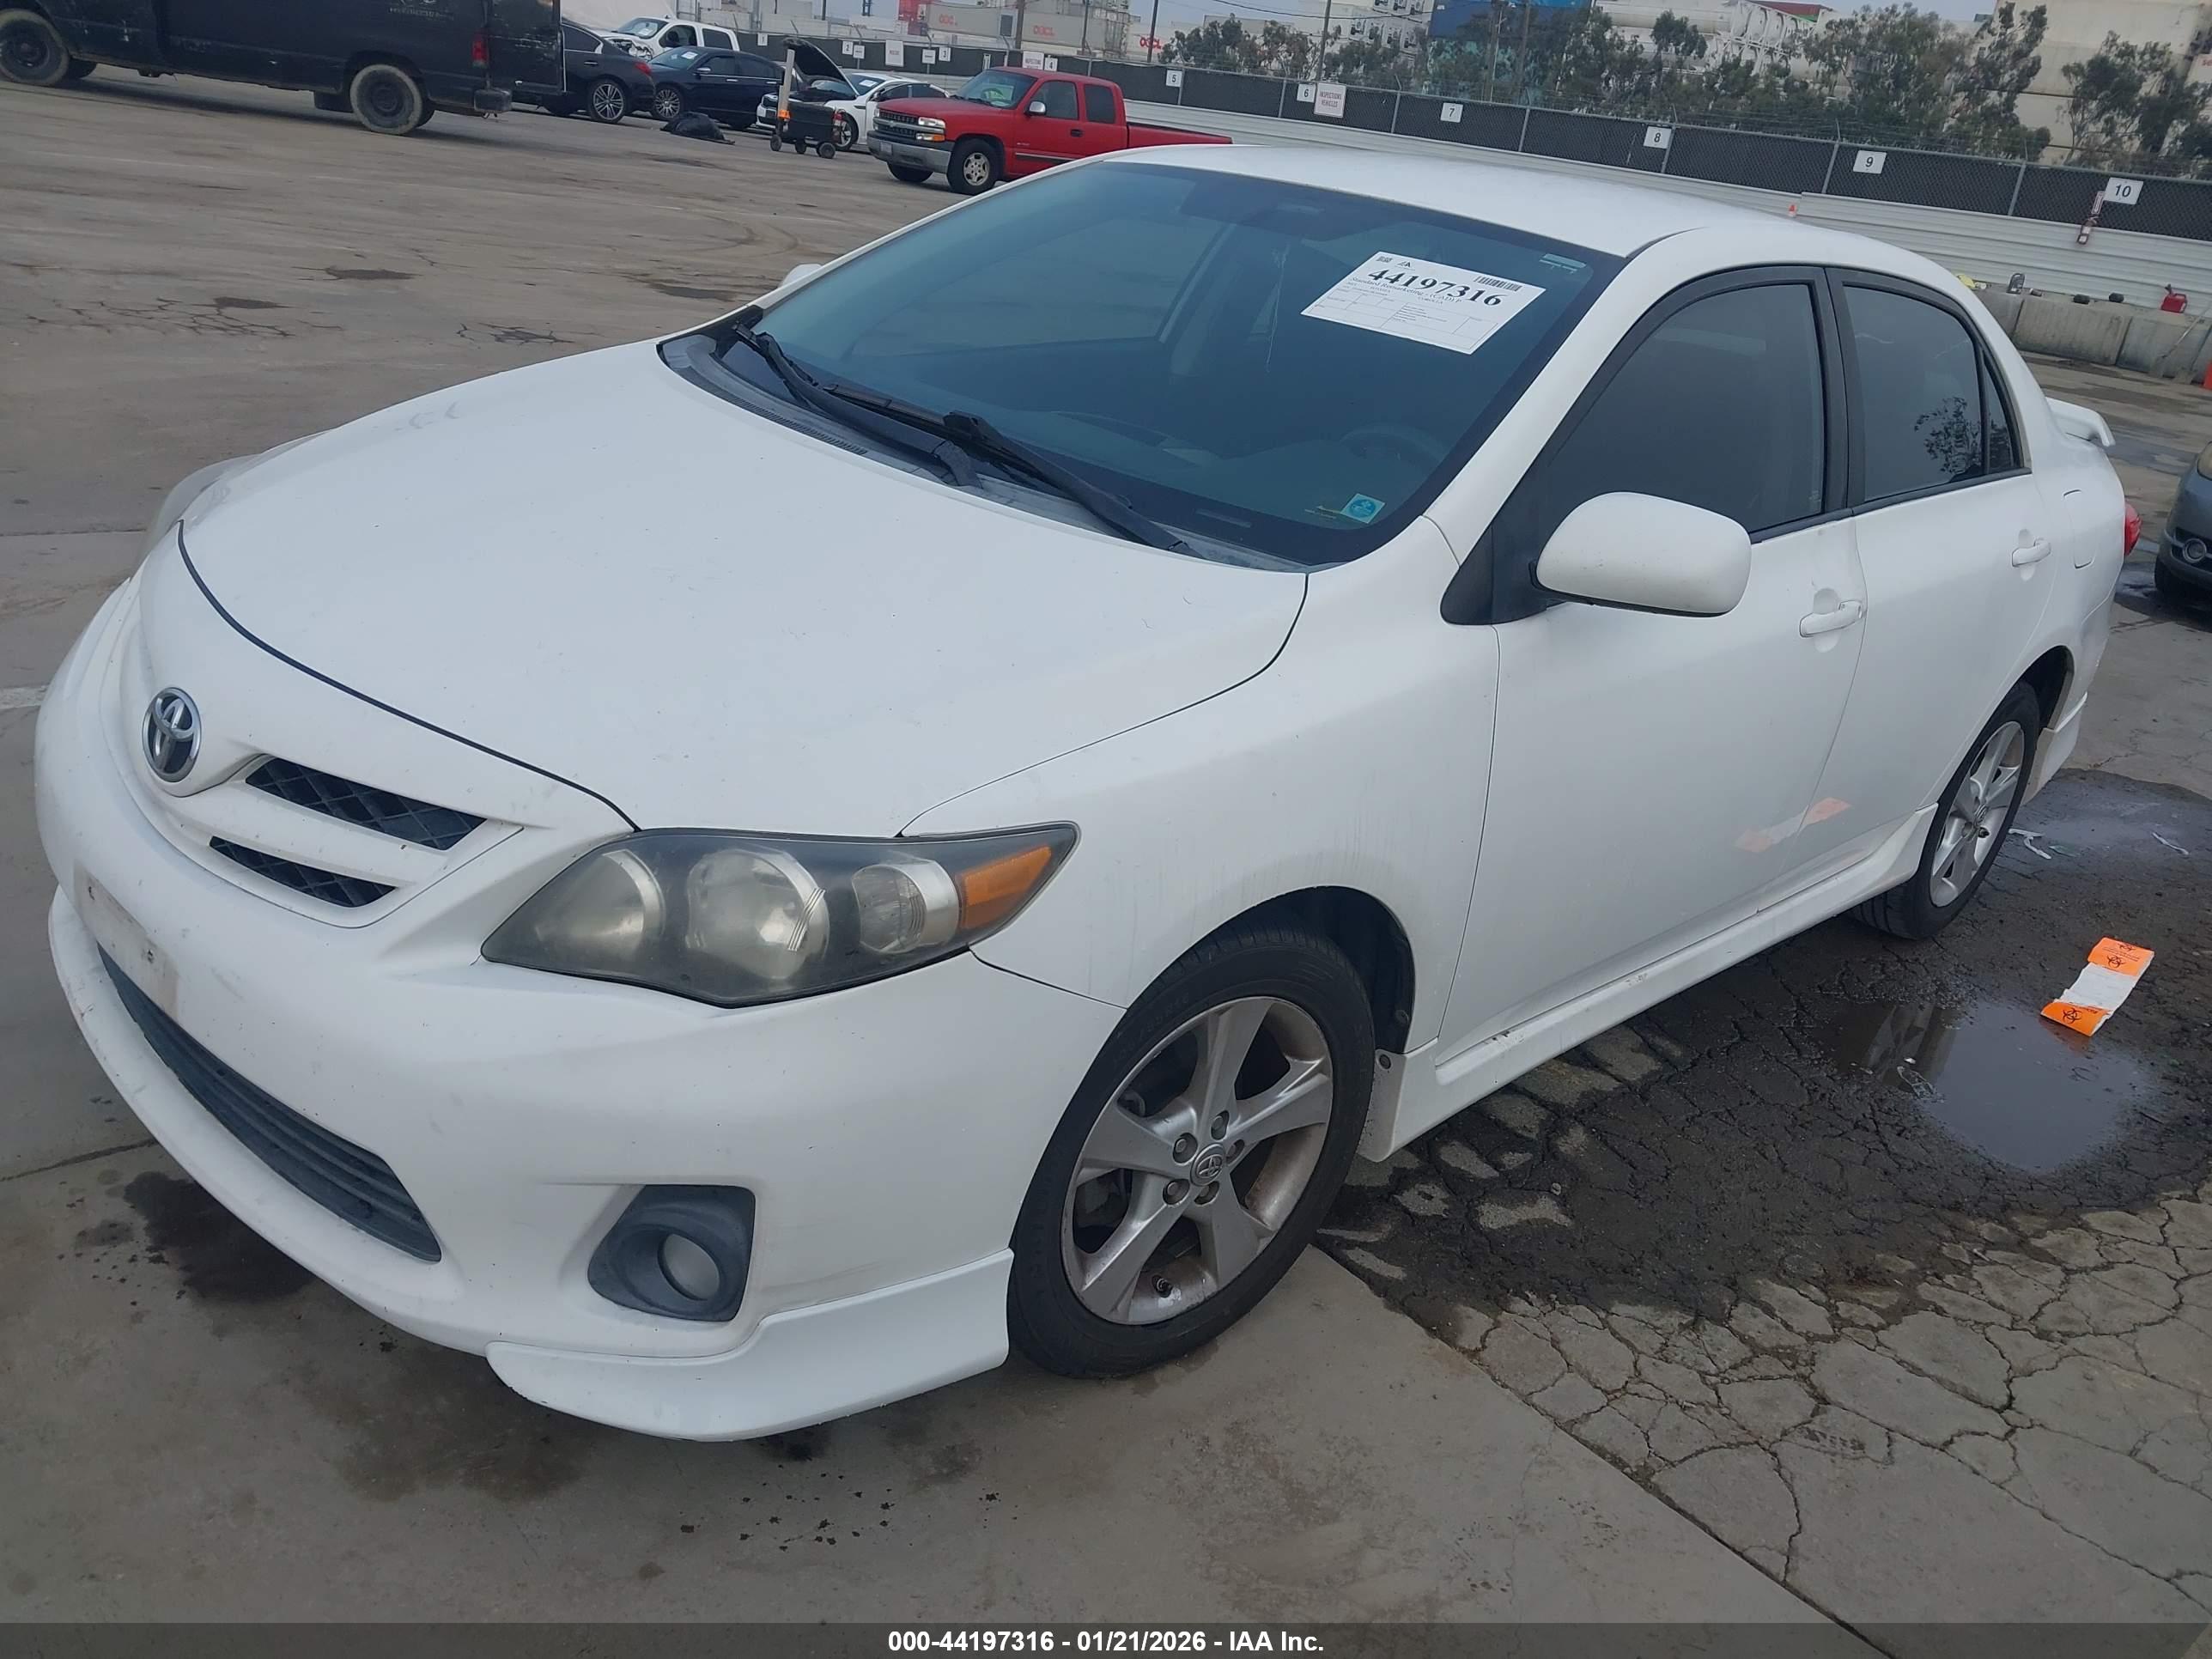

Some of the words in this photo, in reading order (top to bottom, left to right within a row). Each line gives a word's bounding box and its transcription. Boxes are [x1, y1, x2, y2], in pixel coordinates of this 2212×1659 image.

[1048, 61, 1054, 70] 4
[1171, 74, 1177, 82] 5
[1304, 88, 1309, 97] 6
[1449, 108, 1455, 117] 7
[1654, 132, 1661, 143] 8
[1865, 156, 1874, 167] 9
[2115, 184, 2131, 198] 10
[1368, 270, 1509, 306] 44197316
